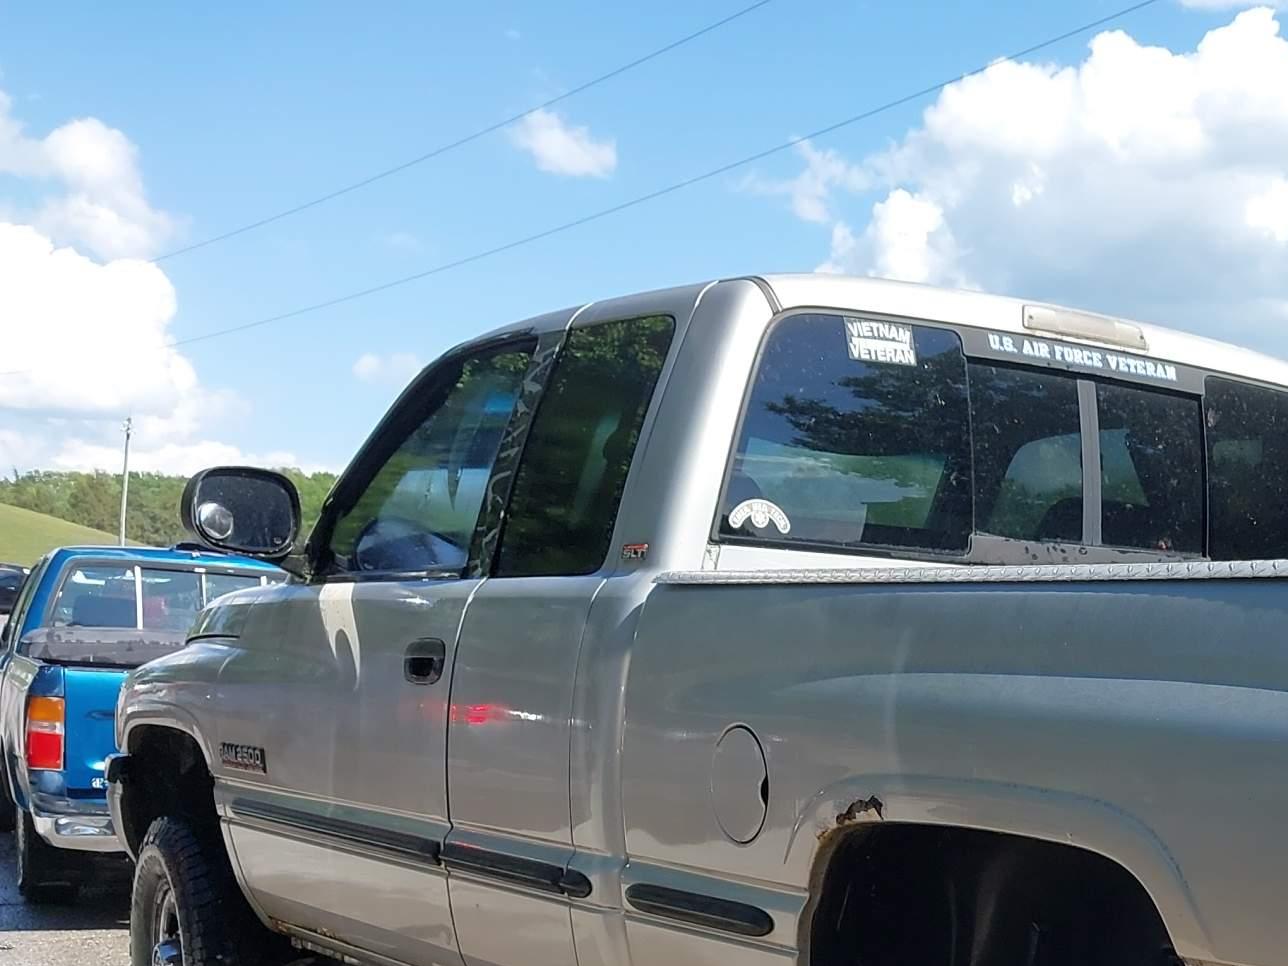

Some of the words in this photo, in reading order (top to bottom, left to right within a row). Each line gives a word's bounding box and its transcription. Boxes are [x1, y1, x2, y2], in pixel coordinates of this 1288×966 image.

[847, 321, 911, 345] VIETNAM
[849, 342, 914, 366] VETERAN
[988, 333, 1018, 353] U.S.
[1022, 339, 1051, 359] AIR
[1054, 344, 1103, 369] FORCE
[1106, 353, 1177, 382] VETERAN
[236, 746, 262, 766] 2500
